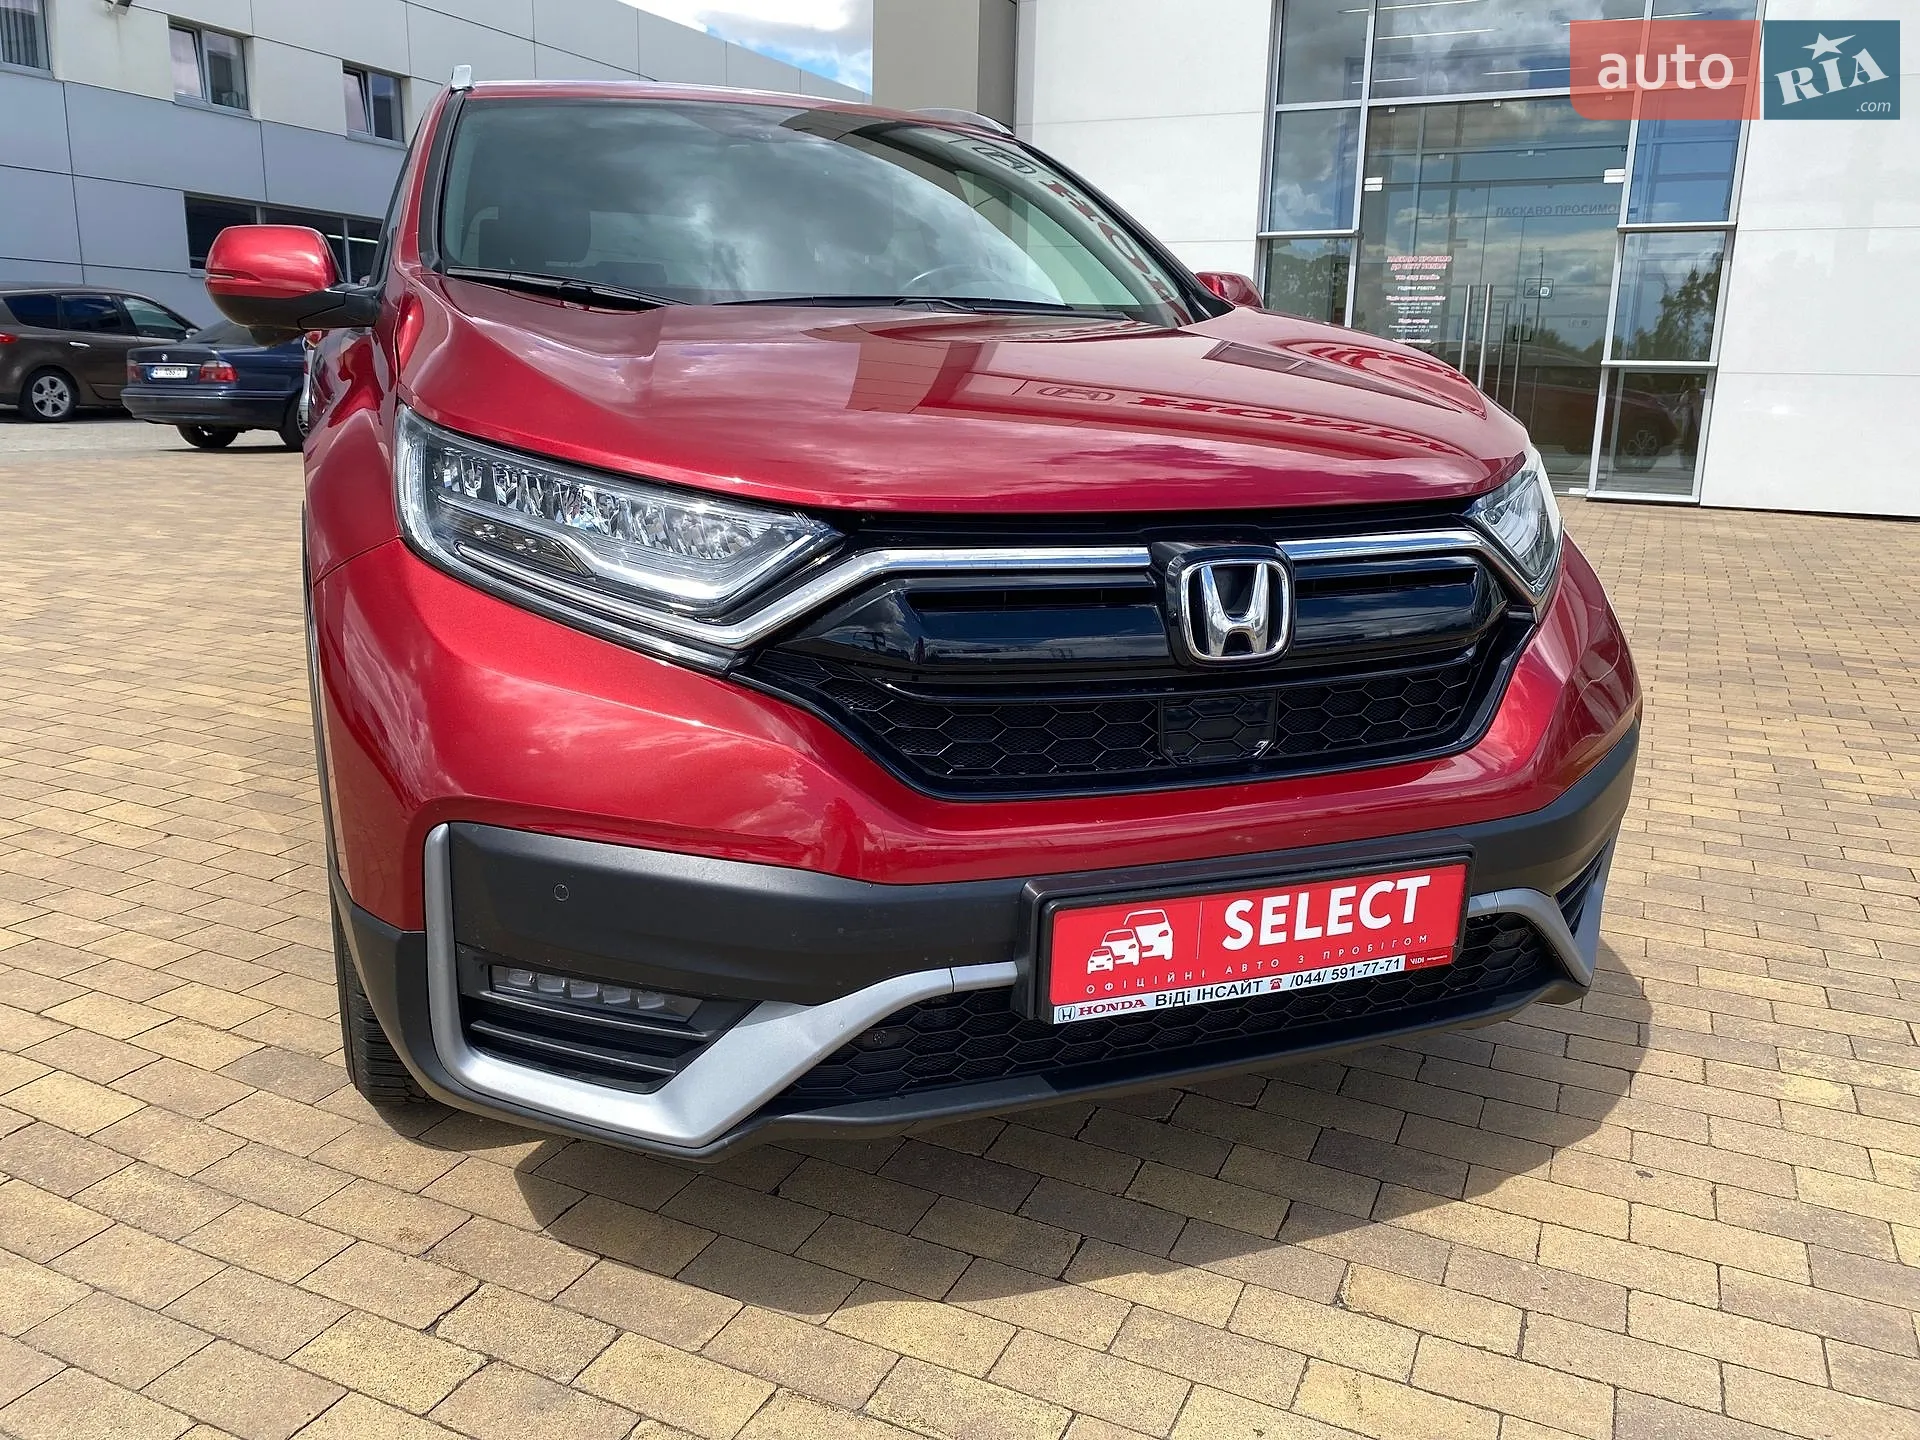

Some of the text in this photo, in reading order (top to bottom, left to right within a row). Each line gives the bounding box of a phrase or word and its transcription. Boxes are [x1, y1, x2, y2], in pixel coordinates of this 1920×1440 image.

[1496, 206, 1553, 217] ЛАСКАВО
[1222, 874, 1431, 951] SELECT
[1078, 998, 1147, 1017] HONDA
[1196, 978, 1264, 1002] ІНСАЙТ
[1290, 968, 1327, 989] /044/
[1330, 957, 1401, 982] 591-77-71
[1086, 933, 1430, 995] ОФІЦІЙНІ АВТО З ПРОБІГОМ
